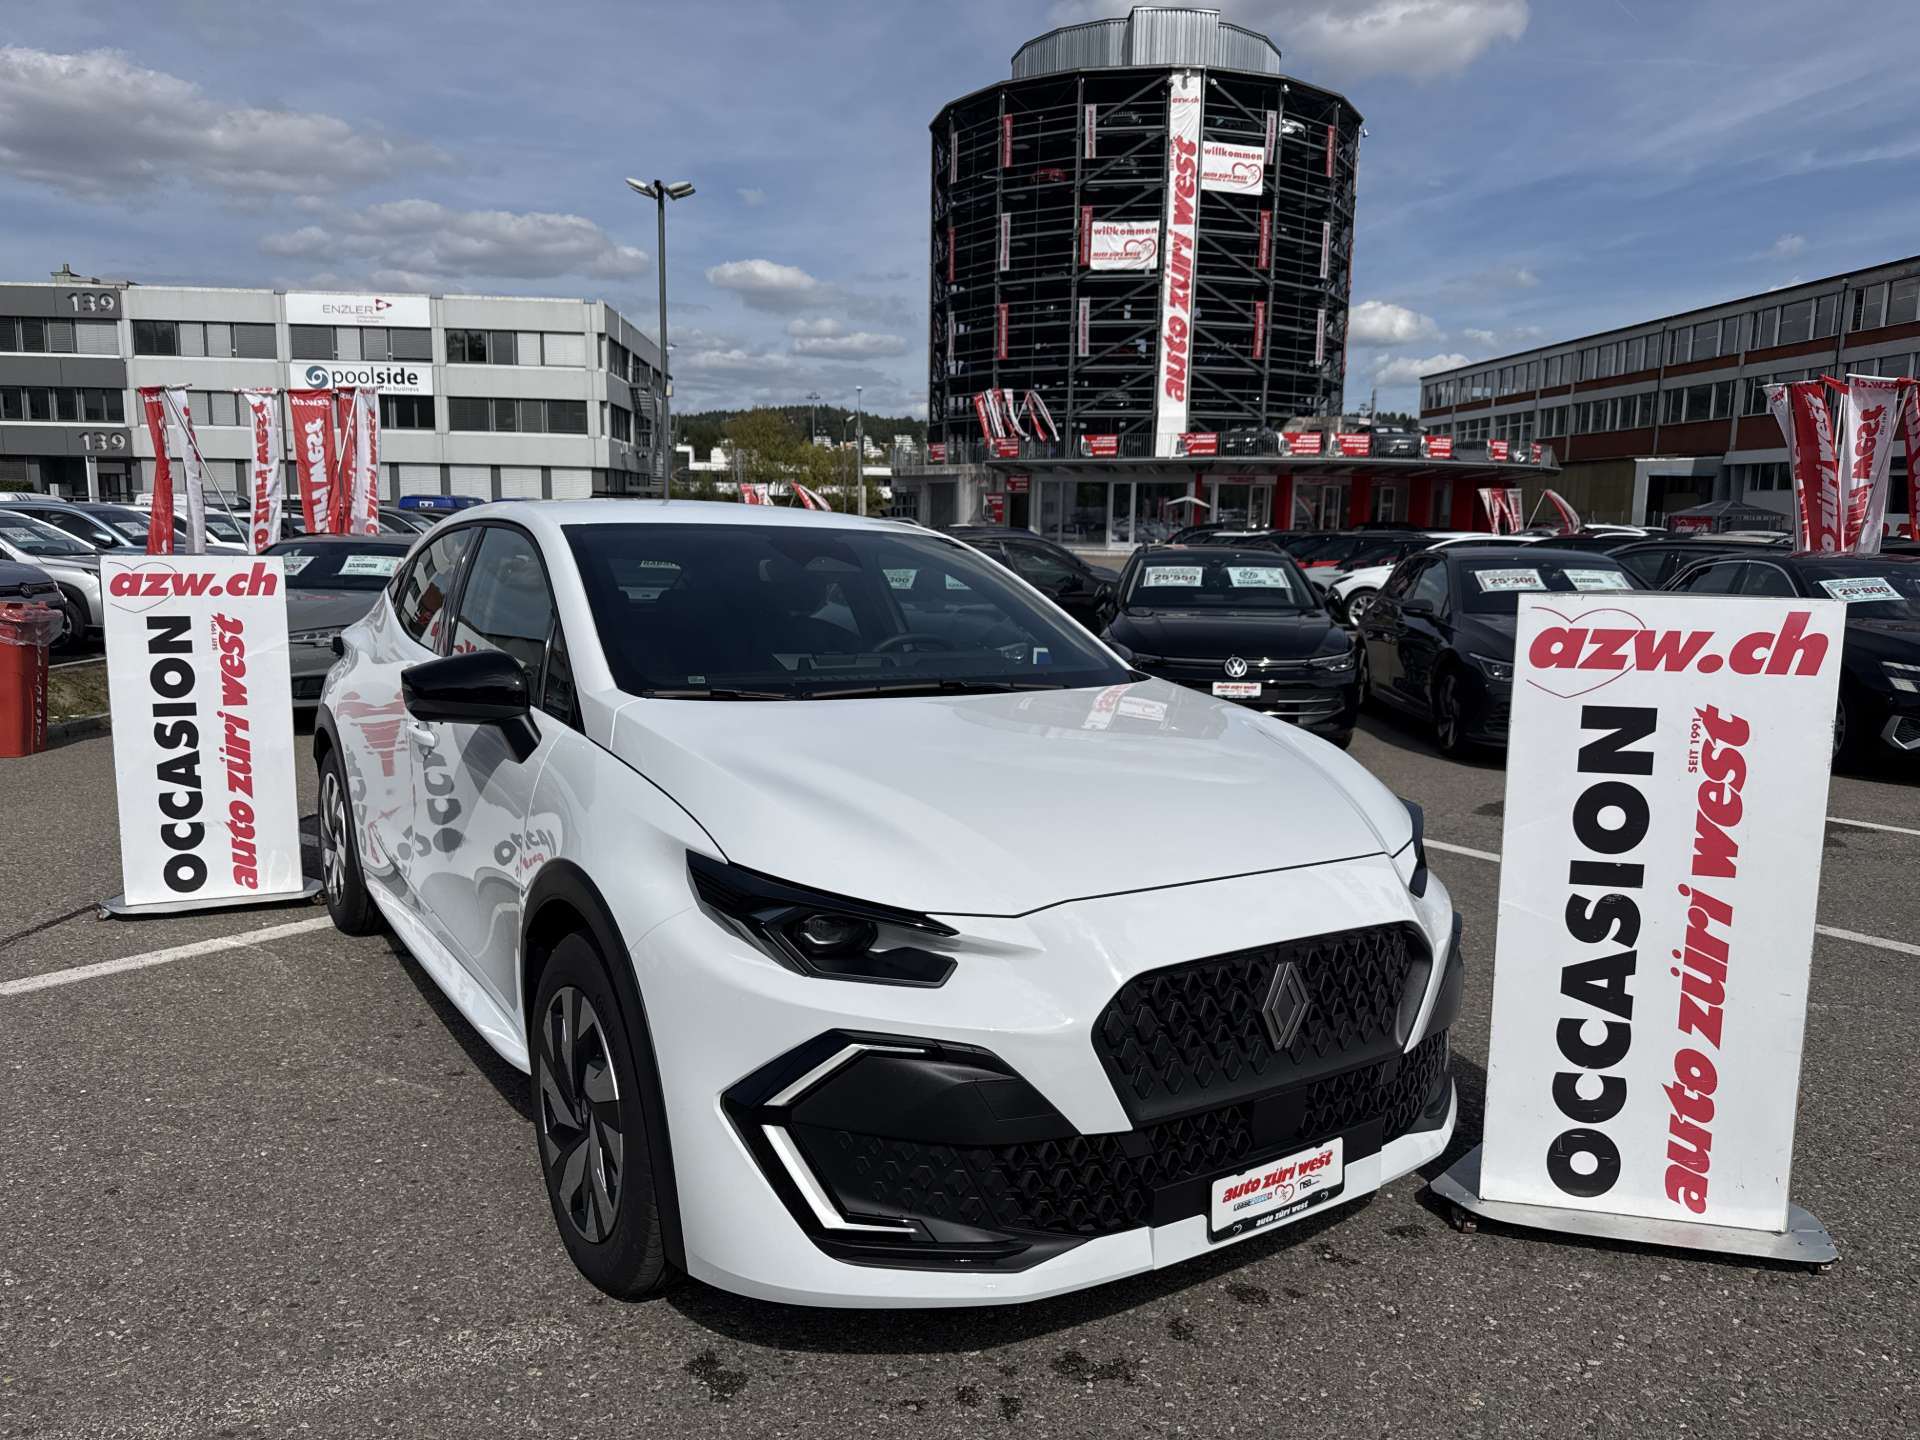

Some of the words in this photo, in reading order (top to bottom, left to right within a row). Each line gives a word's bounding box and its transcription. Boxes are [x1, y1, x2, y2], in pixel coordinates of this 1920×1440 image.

[1173, 135, 1197, 225] west
[1204, 146, 1262, 160] willkommen
[1094, 226, 1157, 235] willkommen
[67, 292, 115, 312] 139
[1165, 229, 1193, 314] züri
[322, 304, 374, 315] ENZLER
[332, 366, 419, 389] poolside
[1163, 315, 1188, 402] auto
[79, 431, 126, 450] 139
[109, 562, 279, 597] azw.ch
[212, 612, 248, 706] west
[1528, 611, 1829, 676] azw.ch
[146, 615, 208, 893] OCCASION
[217, 710, 254, 799] züri
[1687, 748, 1699, 774] SEIT
[1690, 717, 1702, 746] 1991
[1692, 704, 1750, 878] west
[224, 800, 259, 890] auto
[1546, 705, 1658, 1198] OCCASION
[1670, 883, 1733, 1050] züri
[1661, 1048, 1718, 1214] auto
[1222, 1176, 1261, 1203] auto
[1261, 1162, 1297, 1189] züri
[1298, 1149, 1334, 1176] west
[1256, 1216, 1274, 1227] auto
[1274, 1207, 1292, 1220] züri
[1292, 1200, 1309, 1213] west
